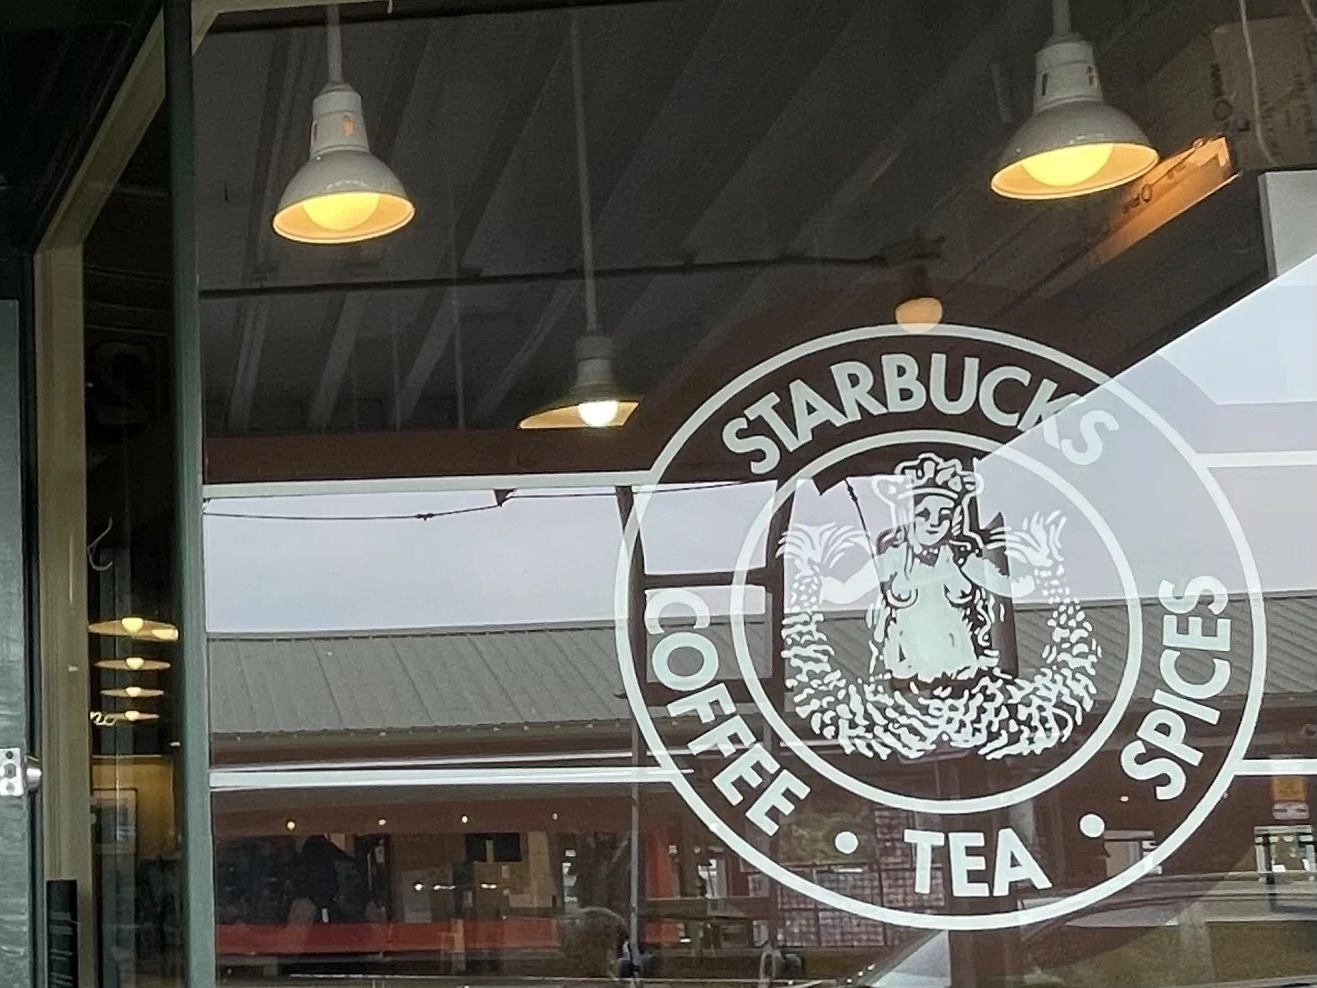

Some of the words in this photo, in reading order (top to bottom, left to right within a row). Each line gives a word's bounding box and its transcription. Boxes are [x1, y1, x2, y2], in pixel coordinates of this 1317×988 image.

[721, 352, 1119, 475] STARBUCKS
[645, 587, 811, 838] COFFEE
[1120, 575, 1233, 802] SPICES
[903, 827, 1053, 898] TEA
